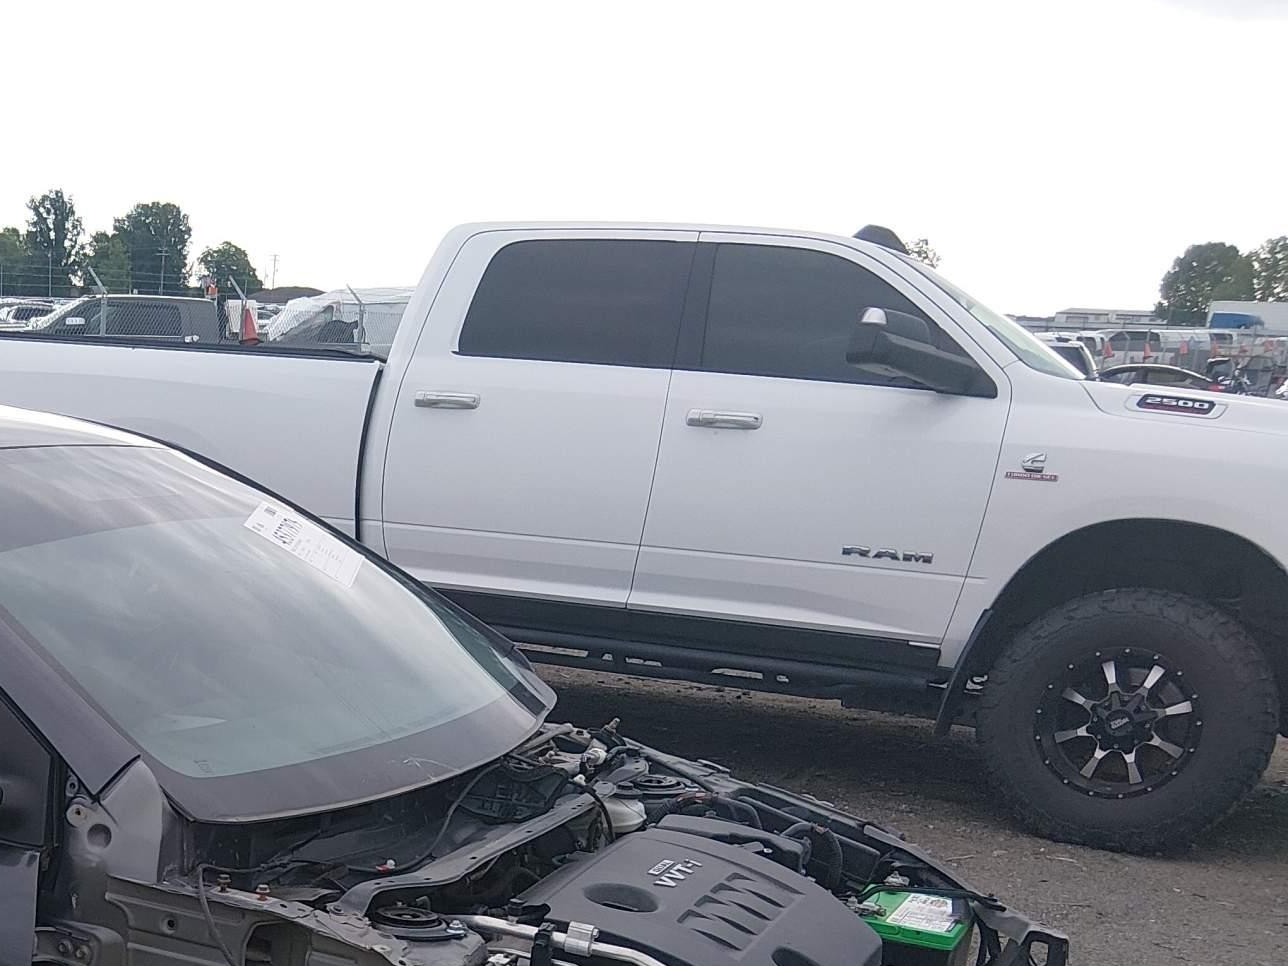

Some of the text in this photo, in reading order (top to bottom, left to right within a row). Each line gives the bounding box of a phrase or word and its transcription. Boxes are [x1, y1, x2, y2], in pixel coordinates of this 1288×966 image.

[1145, 397, 1210, 409] 2500
[841, 544, 934, 564] RAM
[654, 859, 702, 886] VVT-i
